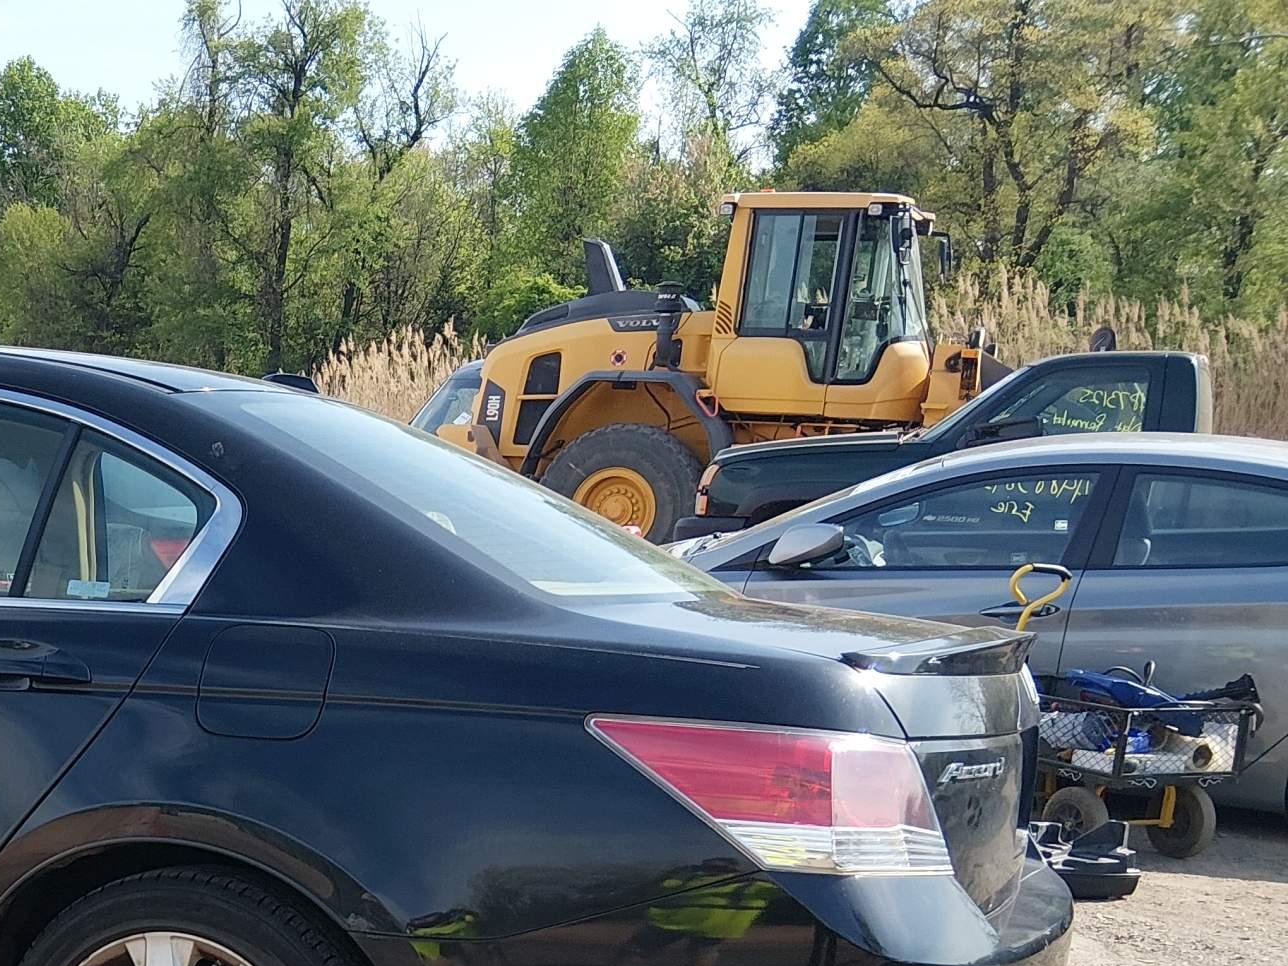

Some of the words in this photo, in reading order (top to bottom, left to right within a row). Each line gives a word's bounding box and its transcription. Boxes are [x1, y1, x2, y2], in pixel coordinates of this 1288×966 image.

[616, 319, 674, 328] VOLV
[486, 395, 501, 421] L90H
[936, 515, 967, 523] 2500
